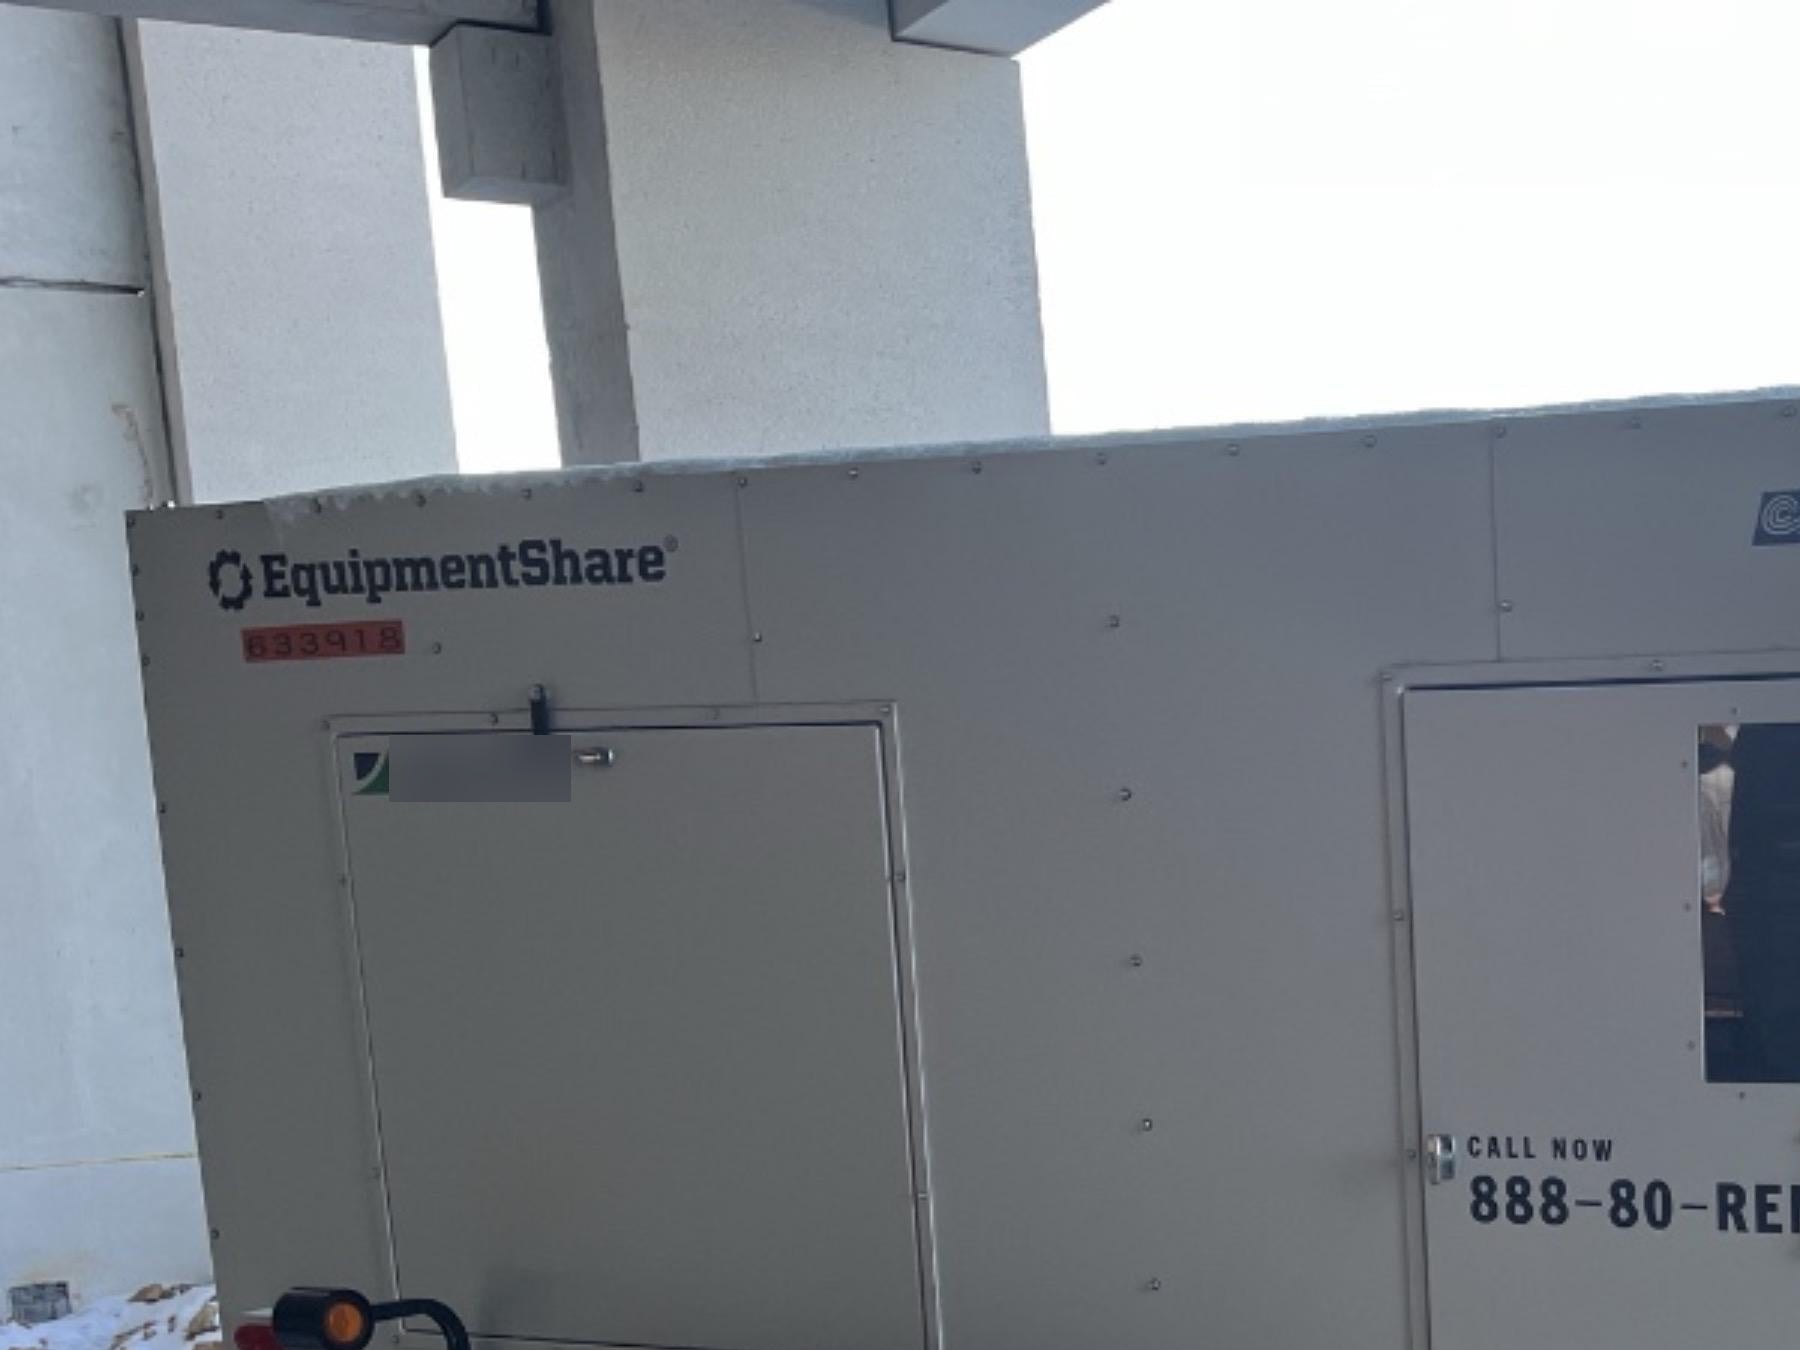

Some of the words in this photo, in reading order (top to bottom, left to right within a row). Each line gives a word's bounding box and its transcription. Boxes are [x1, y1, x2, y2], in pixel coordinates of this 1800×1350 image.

[260, 538, 667, 604] EquipmentShare
[247, 626, 402, 659] 633918
[1467, 1135, 1537, 1160] CALL
[1552, 1137, 1613, 1162] NOW
